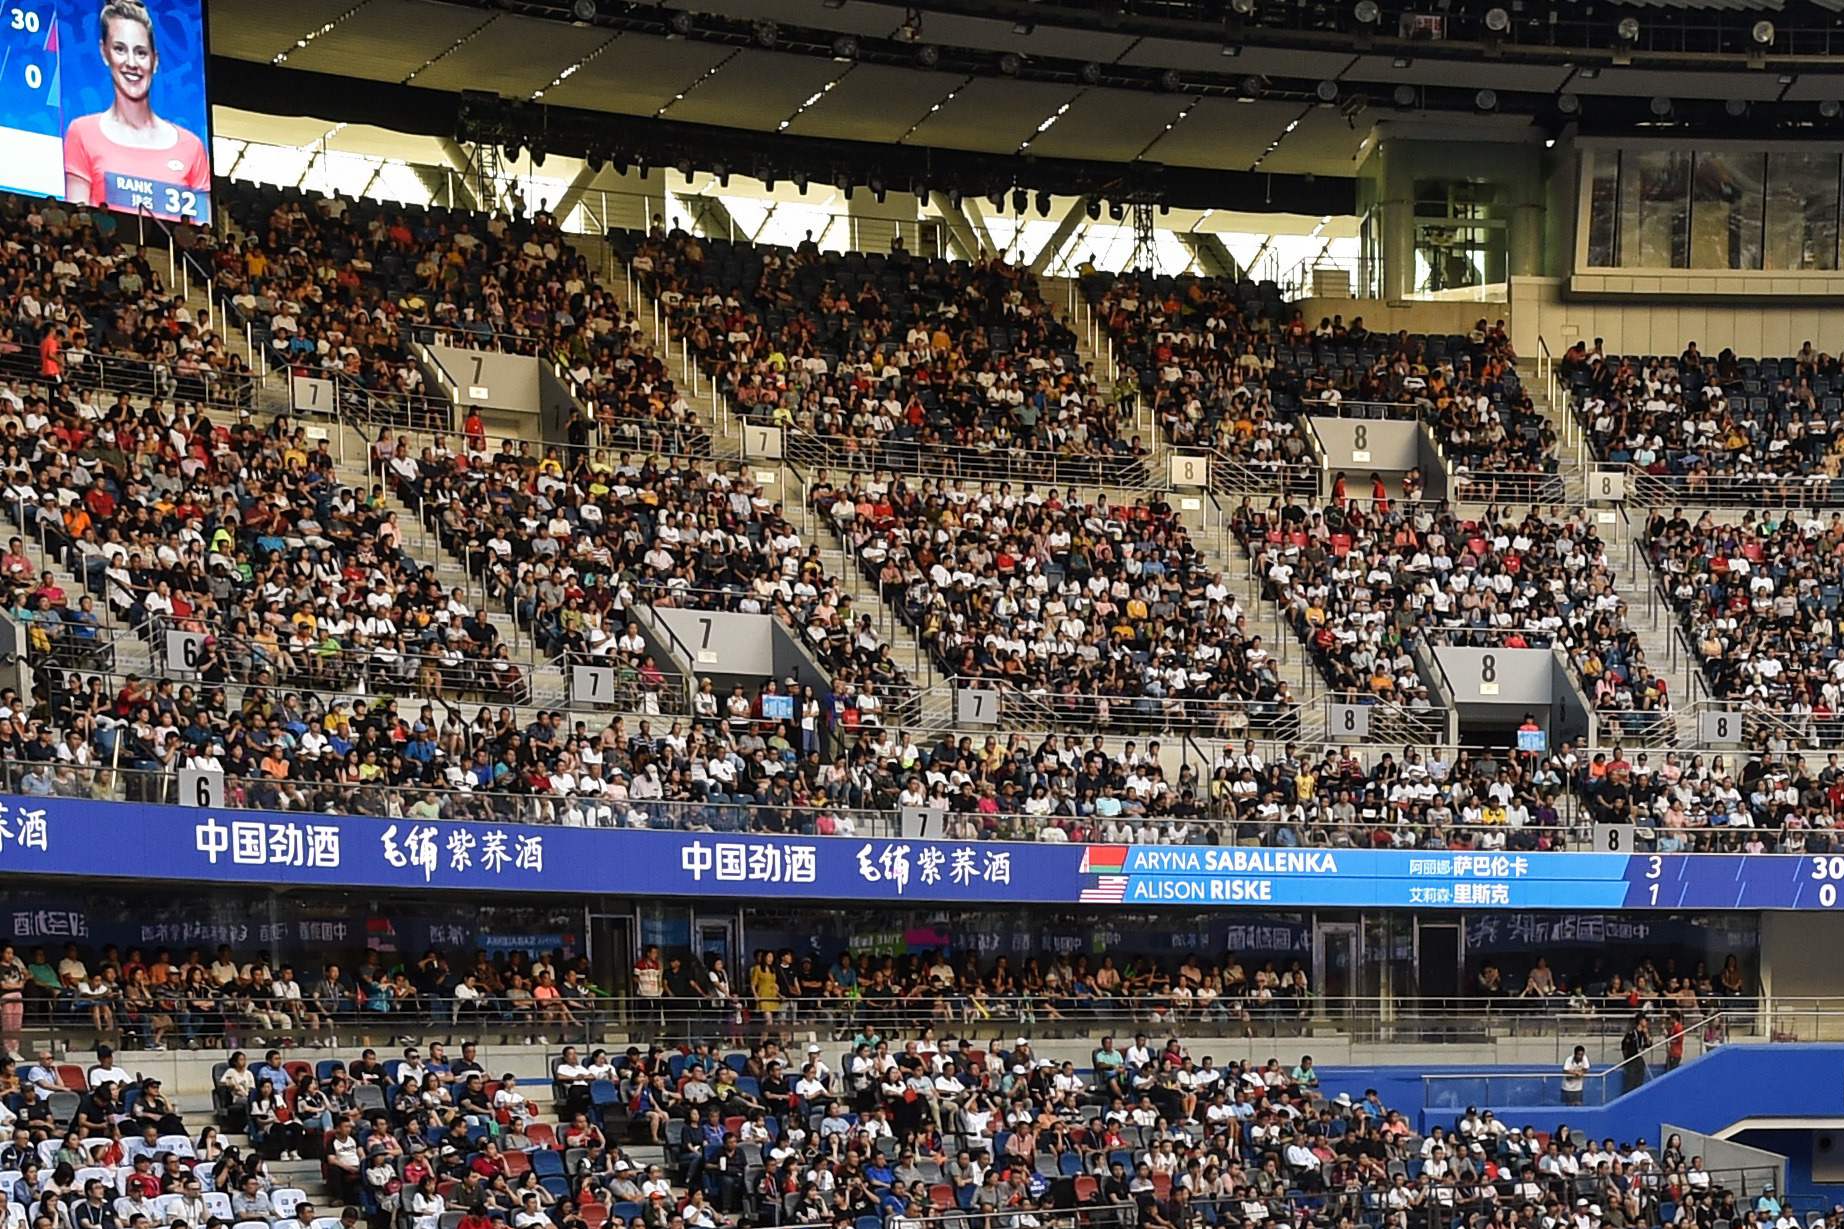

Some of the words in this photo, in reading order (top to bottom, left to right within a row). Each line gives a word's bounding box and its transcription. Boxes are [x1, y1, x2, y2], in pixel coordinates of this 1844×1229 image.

[11, 9, 40, 32] 30
[25, 65, 42, 88] 0
[116, 176, 153, 194] RANK
[165, 188, 198, 216] 32
[471, 356, 484, 385] 7
[310, 385, 319, 406] 7
[759, 431, 768, 452] 7
[1354, 424, 1368, 450] 8
[1185, 461, 1195, 480] 8
[1602, 477, 1611, 496] 8
[699, 618, 713, 650] 7
[183, 638, 198, 669] 6
[1481, 654, 1497, 683] 8
[589, 672, 600, 697] 7
[973, 696, 983, 718] 7
[1344, 709, 1356, 731] 8
[1717, 717, 1728, 739] 8
[196, 776, 211, 809] 6
[918, 814, 929, 838] 7
[195, 818, 340, 868] 中国劲酒
[1608, 829, 1620, 852] 8
[681, 840, 816, 883] 中国劲酒
[1134, 852, 1200, 870] ARYNA
[1205, 847, 1337, 873] SABALENKA
[1645, 855, 1662, 879] 3
[1134, 881, 1205, 899] ALISON
[1210, 879, 1271, 900] RISKE
[1649, 883, 1659, 906] 1
[1819, 883, 1837, 907] 0
